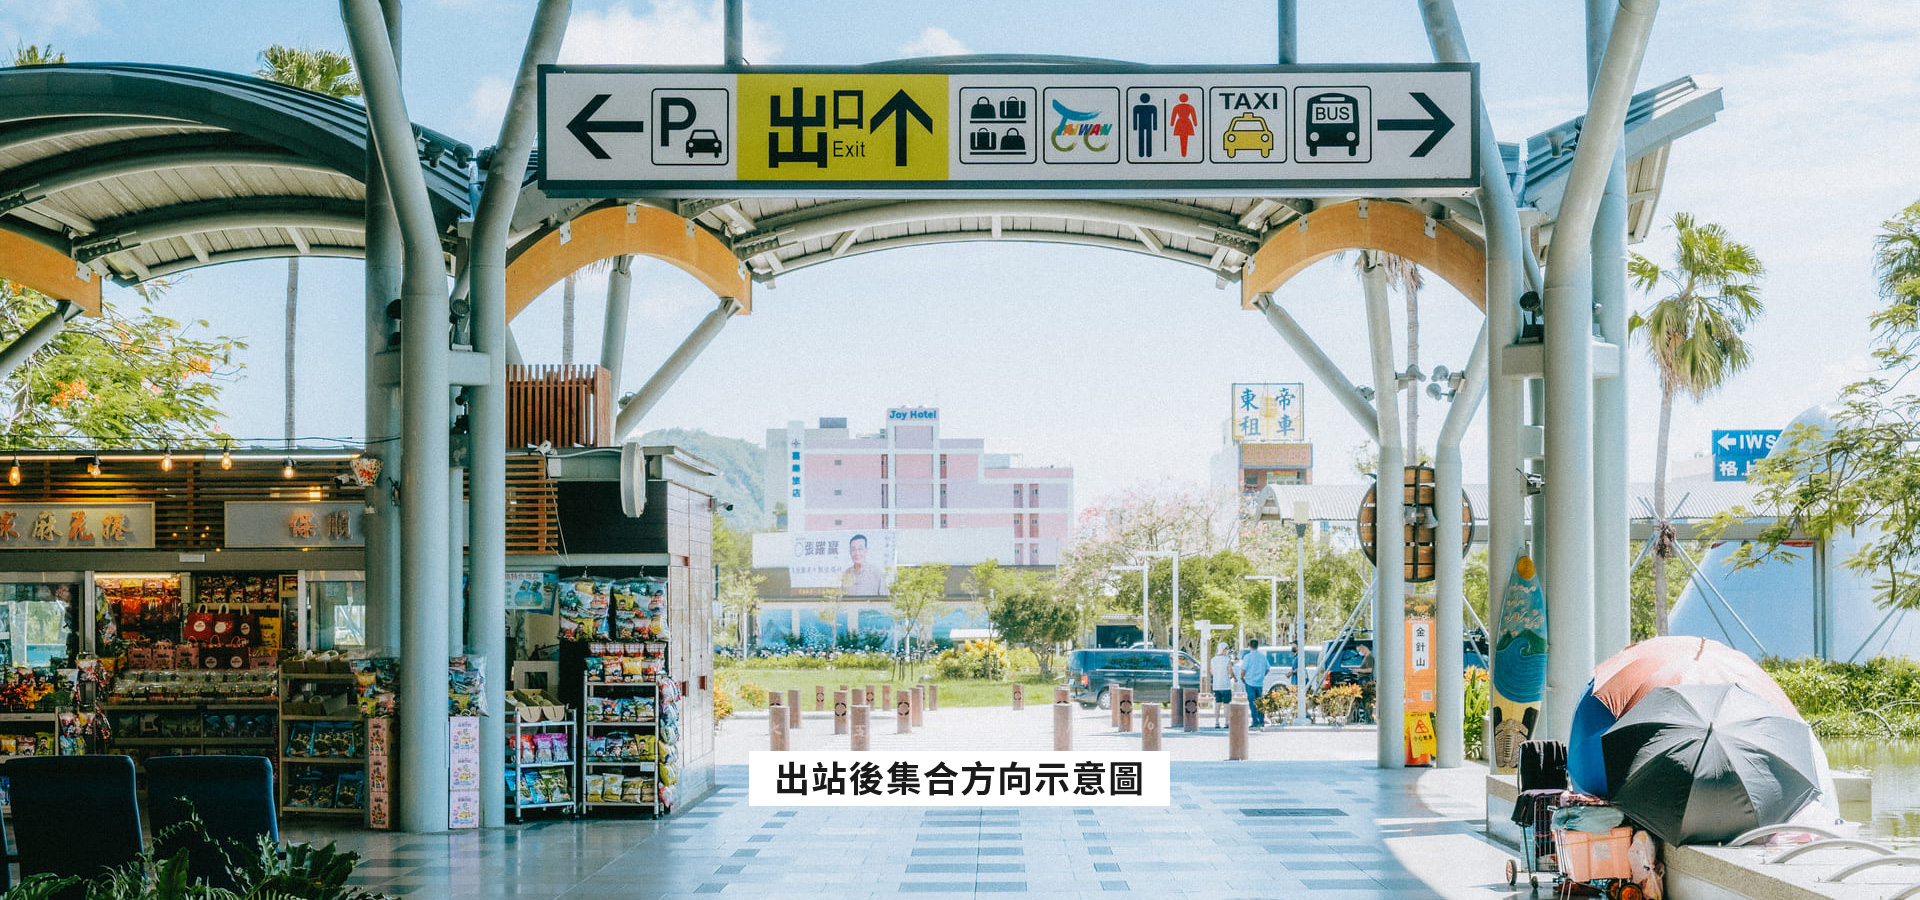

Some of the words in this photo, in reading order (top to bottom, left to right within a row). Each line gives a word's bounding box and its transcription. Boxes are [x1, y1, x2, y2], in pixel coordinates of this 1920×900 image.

[1219, 93, 1278, 110] TAXI
[661, 97, 697, 147] P
[1052, 99, 1113, 136] TAIWAN
[1315, 106, 1350, 121] BUS
[768, 87, 864, 168] 出口
[833, 140, 866, 158] Exit
[1241, 388, 1296, 411] 東帝
[889, 410, 907, 421] Joy
[910, 410, 937, 419] Hotel
[1239, 414, 1296, 437] 租車
[1415, 626, 1426, 667] 金針山
